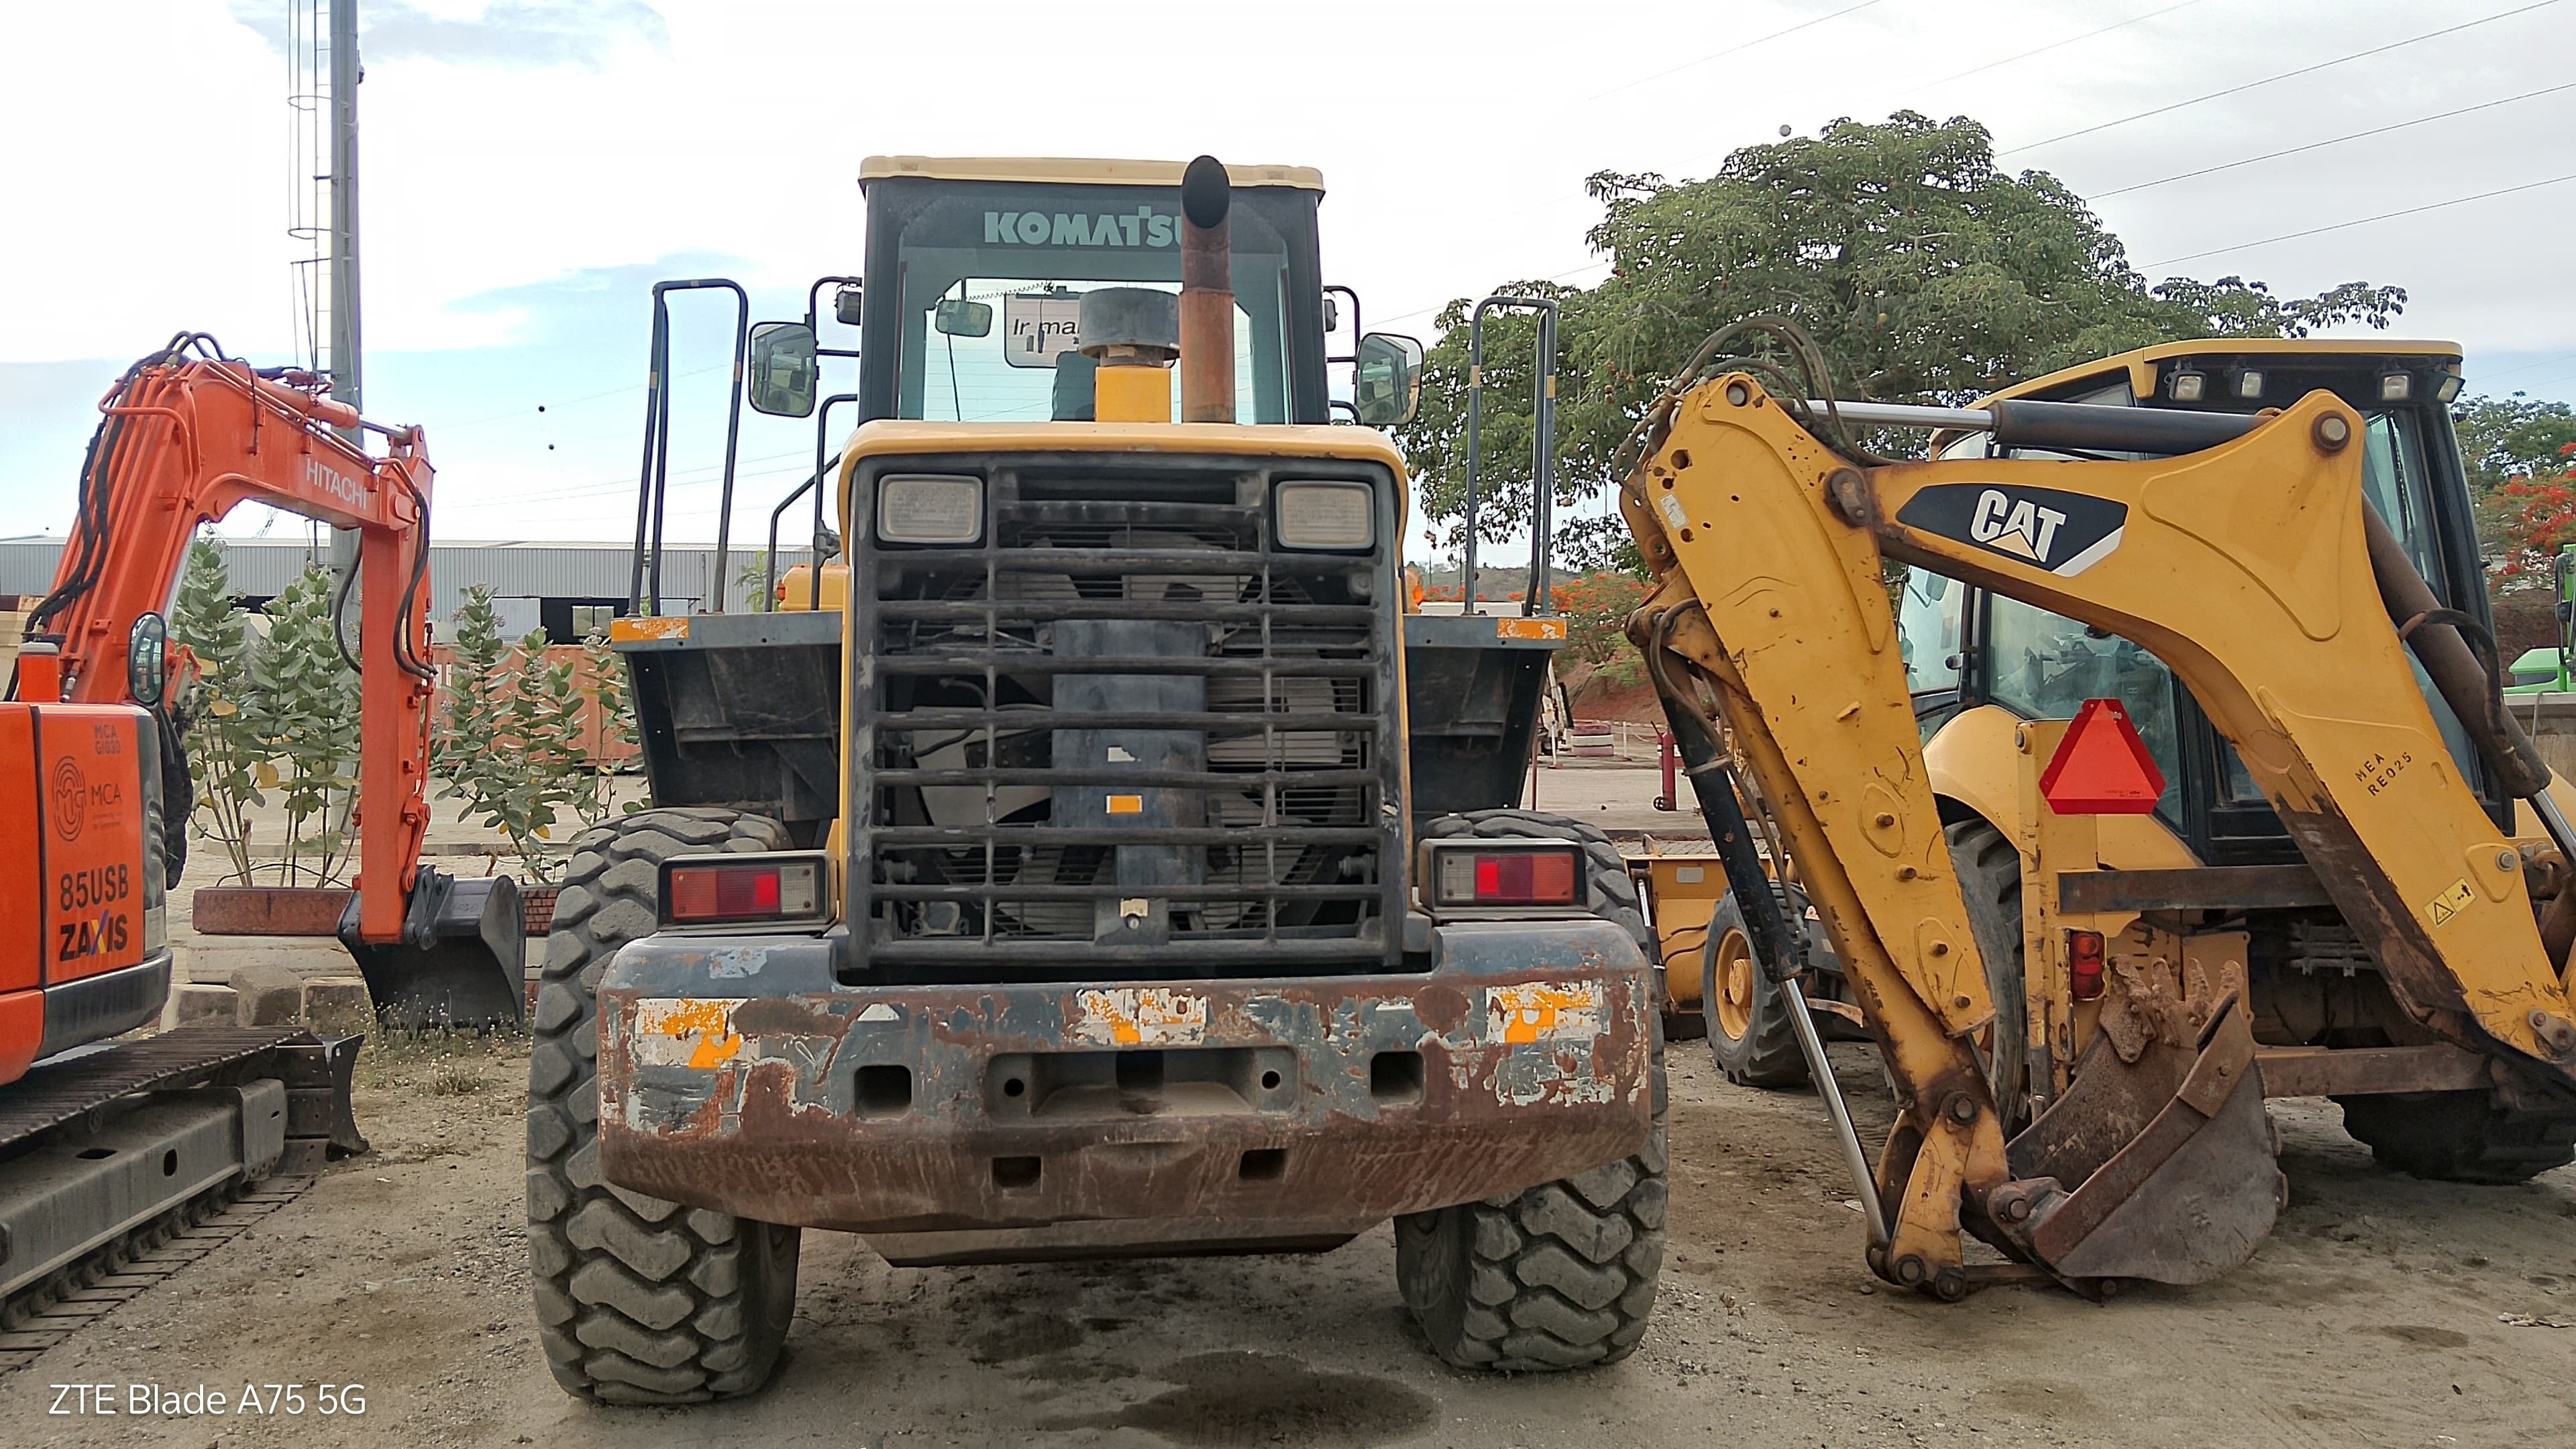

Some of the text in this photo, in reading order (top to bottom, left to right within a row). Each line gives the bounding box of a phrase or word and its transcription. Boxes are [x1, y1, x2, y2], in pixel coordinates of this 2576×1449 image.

[984, 206, 1181, 247] KOMATS
[306, 458, 367, 509] HITACHI
[1970, 489, 2067, 562] CAT
[95, 724, 117, 739] MCA
[2355, 753, 2385, 782] MEA
[91, 784, 122, 806] MCA
[60, 863, 129, 911] 85USB
[59, 909, 128, 962] ZAXIS
